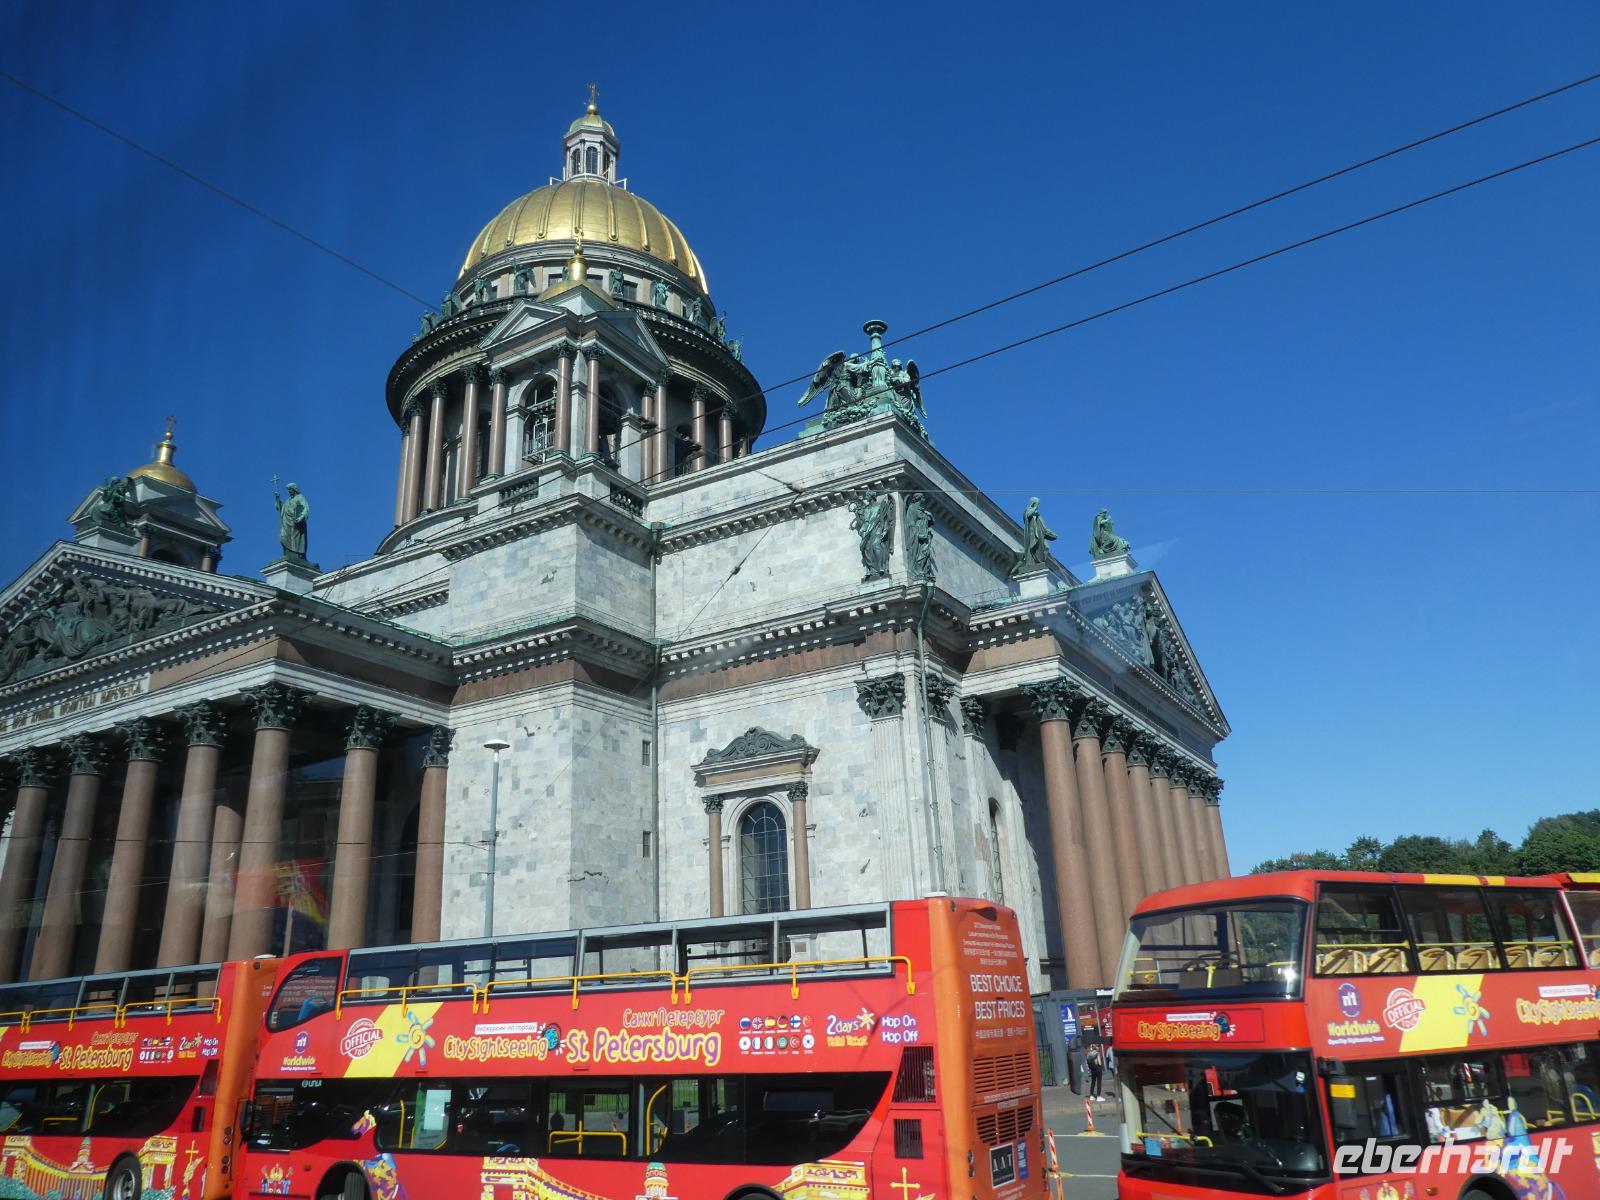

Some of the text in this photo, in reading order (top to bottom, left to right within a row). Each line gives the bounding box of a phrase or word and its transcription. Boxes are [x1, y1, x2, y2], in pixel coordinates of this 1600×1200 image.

[970, 975, 1023, 992] BEST CHOICE
[975, 1001, 1026, 1020] BEST PRICES
[1387, 998, 1425, 1022] OFFICIAL
[882, 1014, 917, 1028] Hop On
[1138, 1021, 1220, 1041] CitySightseeing
[344, 1028, 382, 1051] OFFICIAL
[882, 1029, 918, 1043] Hop Off
[353, 1043, 372, 1056] TOUR
[444, 1035, 549, 1062] CitySightseeing
[566, 1027, 721, 1067] St Petersburg
[72, 1044, 134, 1072] Petersburg
